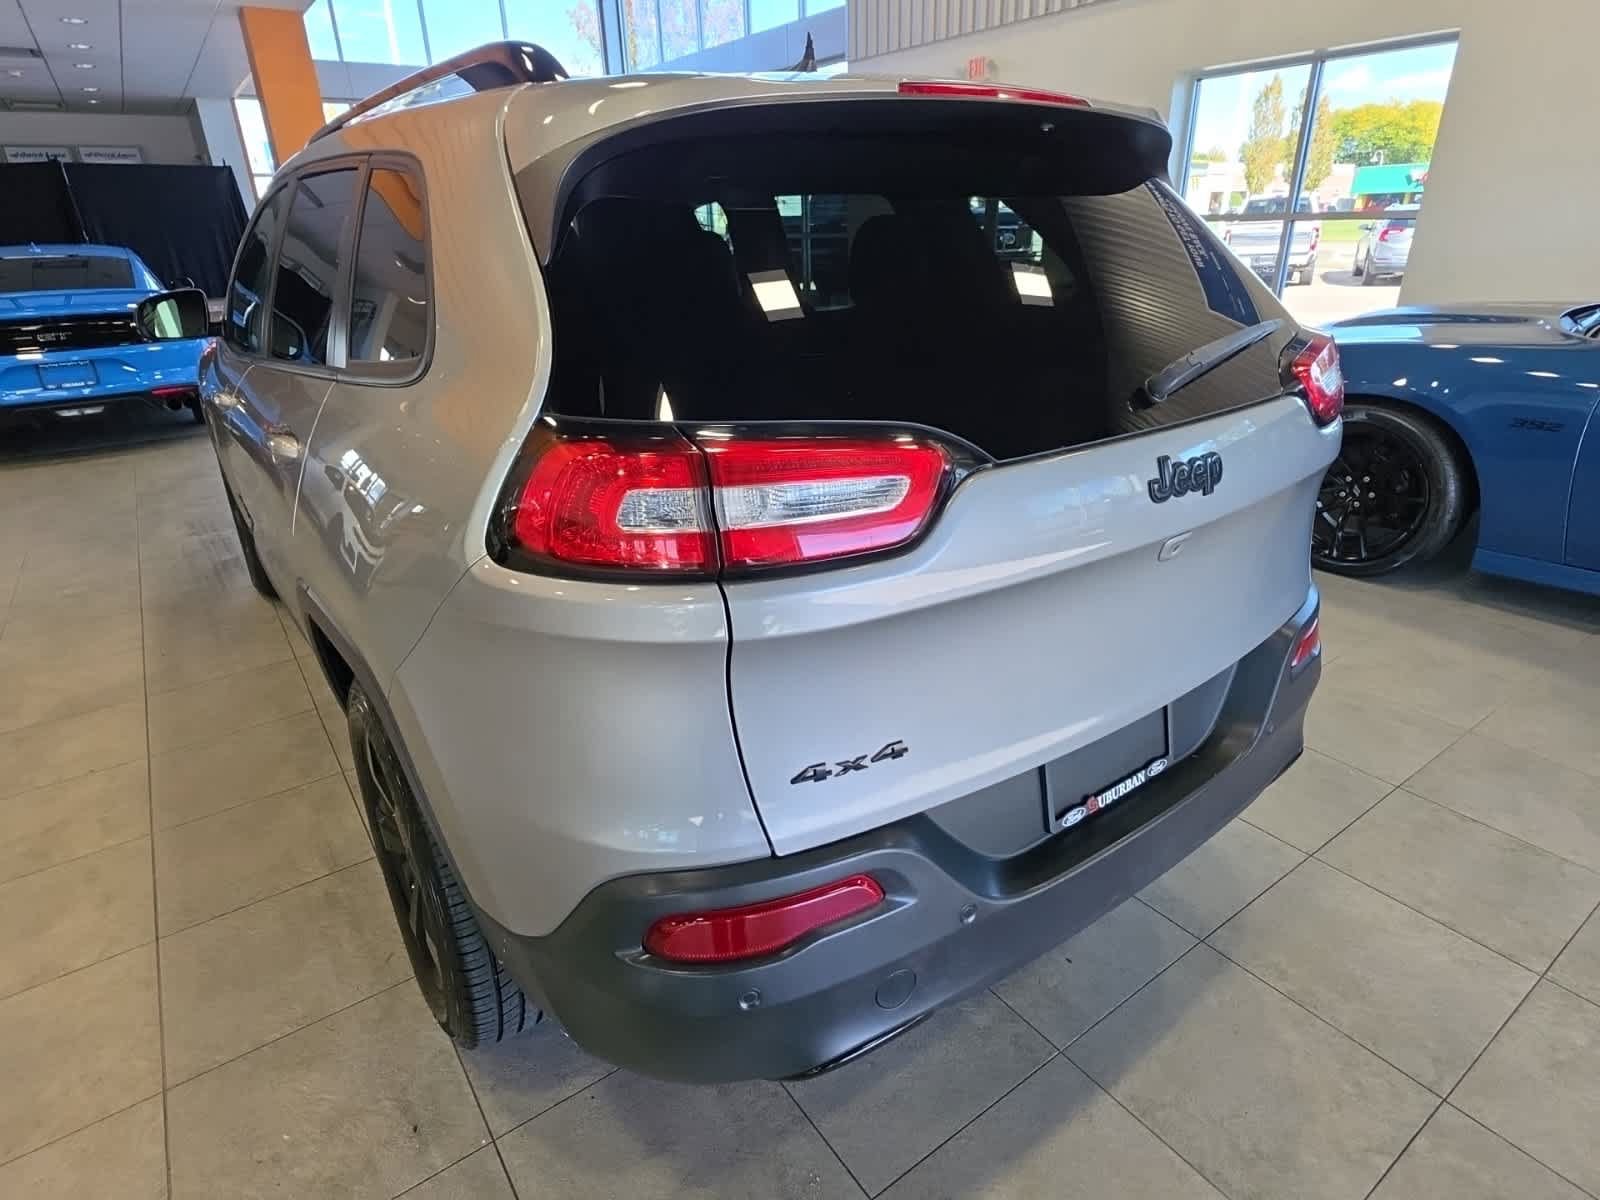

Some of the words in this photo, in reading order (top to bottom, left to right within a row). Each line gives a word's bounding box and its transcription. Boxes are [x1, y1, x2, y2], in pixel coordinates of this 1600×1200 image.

[1147, 452, 1223, 504] Jeep
[790, 739, 909, 785] 4x4
[1087, 769, 1146, 815] SUBURBAN
